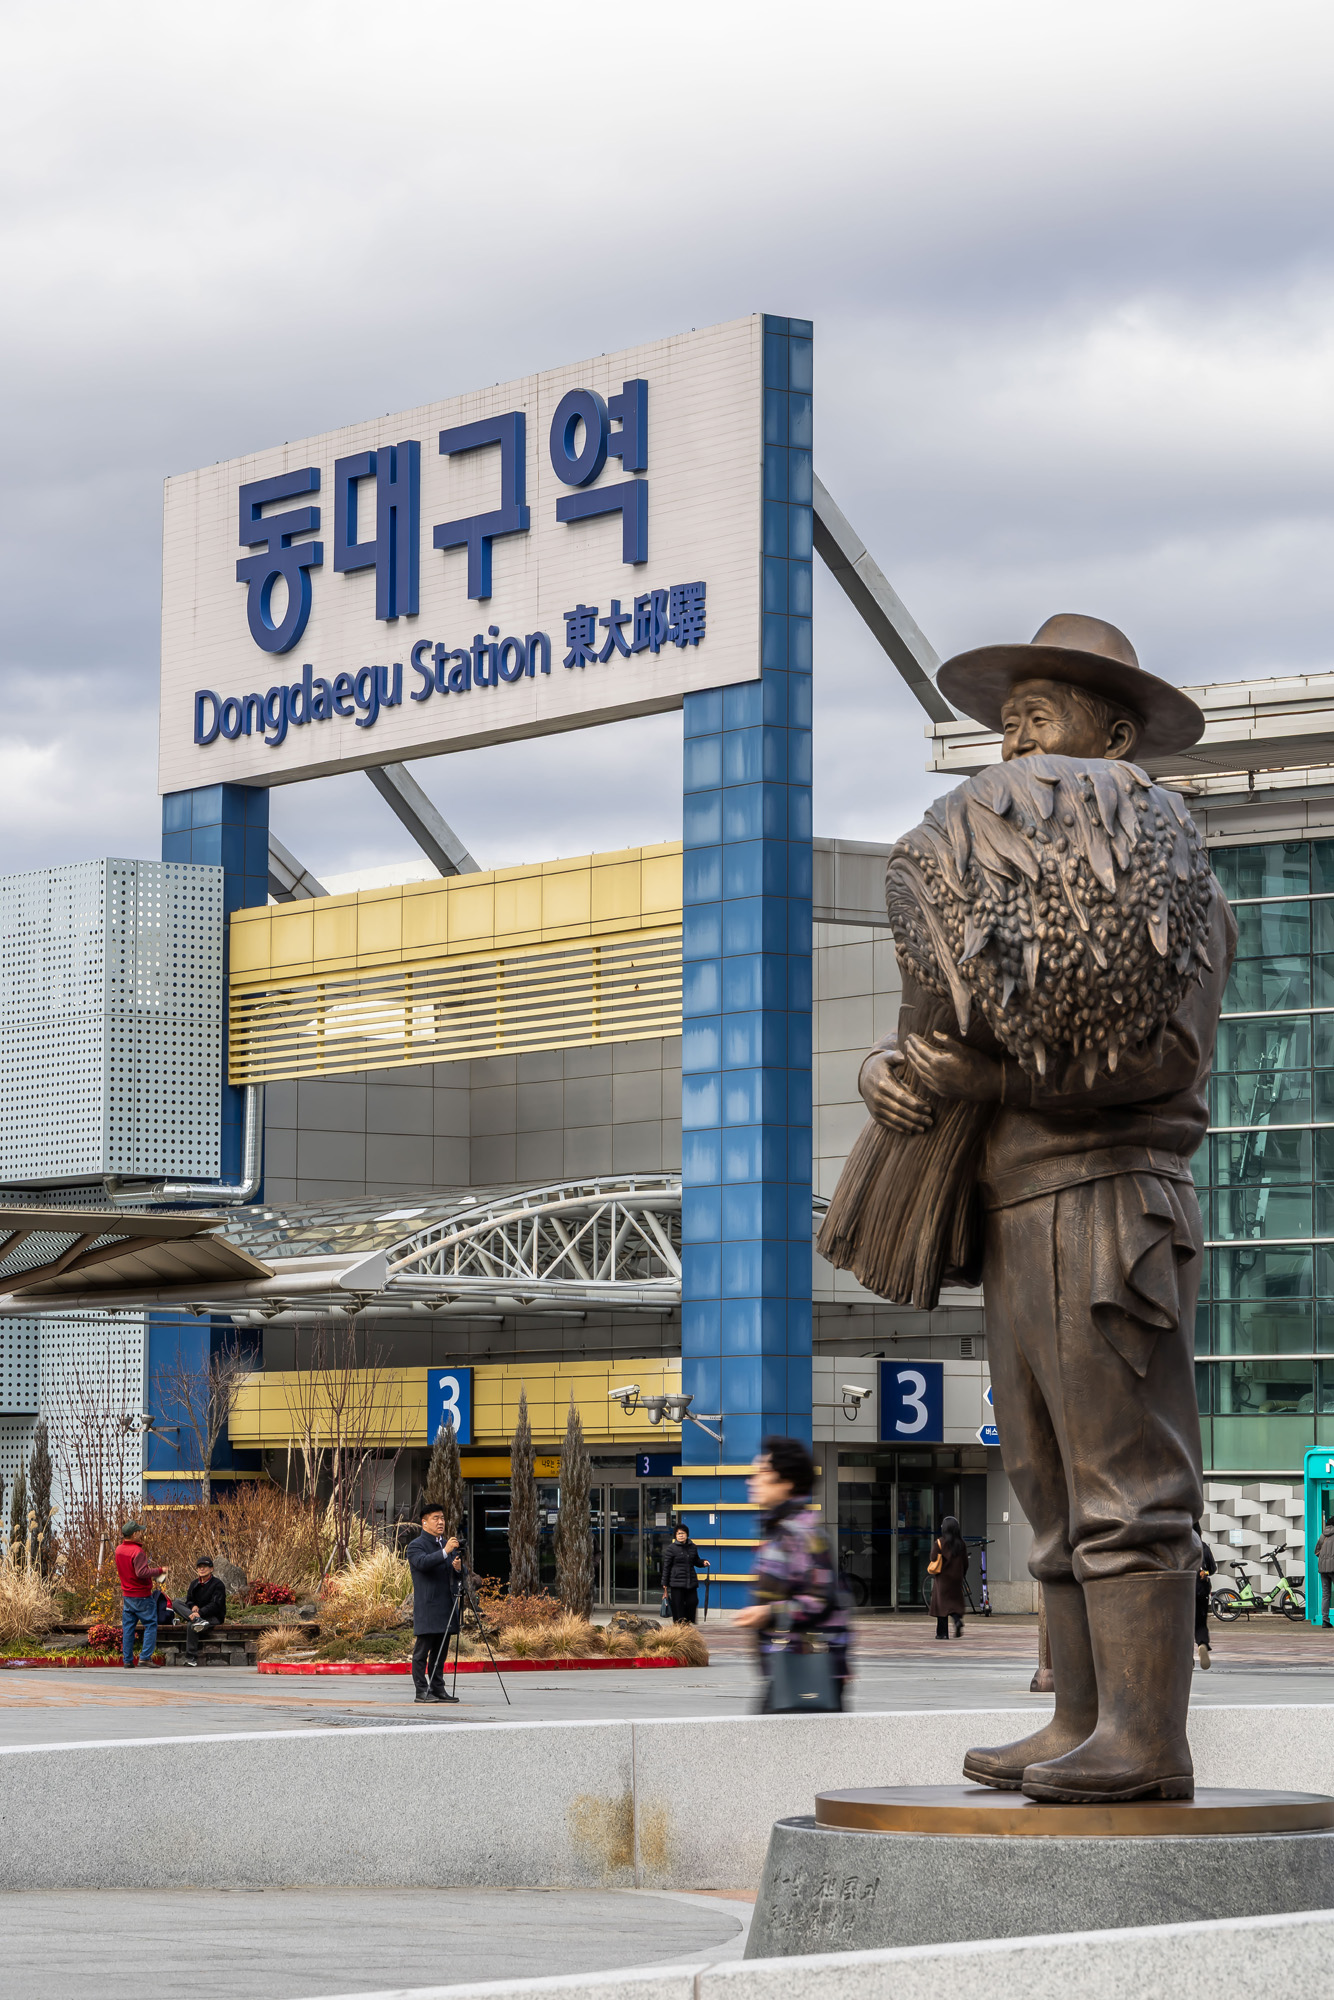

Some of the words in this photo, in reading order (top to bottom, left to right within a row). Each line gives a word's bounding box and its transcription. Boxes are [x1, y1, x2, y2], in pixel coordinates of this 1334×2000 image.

[236, 378, 648, 655] 동대구역
[194, 662, 403, 747] Dongdaegu
[411, 625, 551, 702] Station
[563, 581, 707, 669] 東大邱驛
[439, 1375, 461, 1436] 3
[895, 1370, 929, 1434] 3
[643, 1456, 650, 1475] 3
